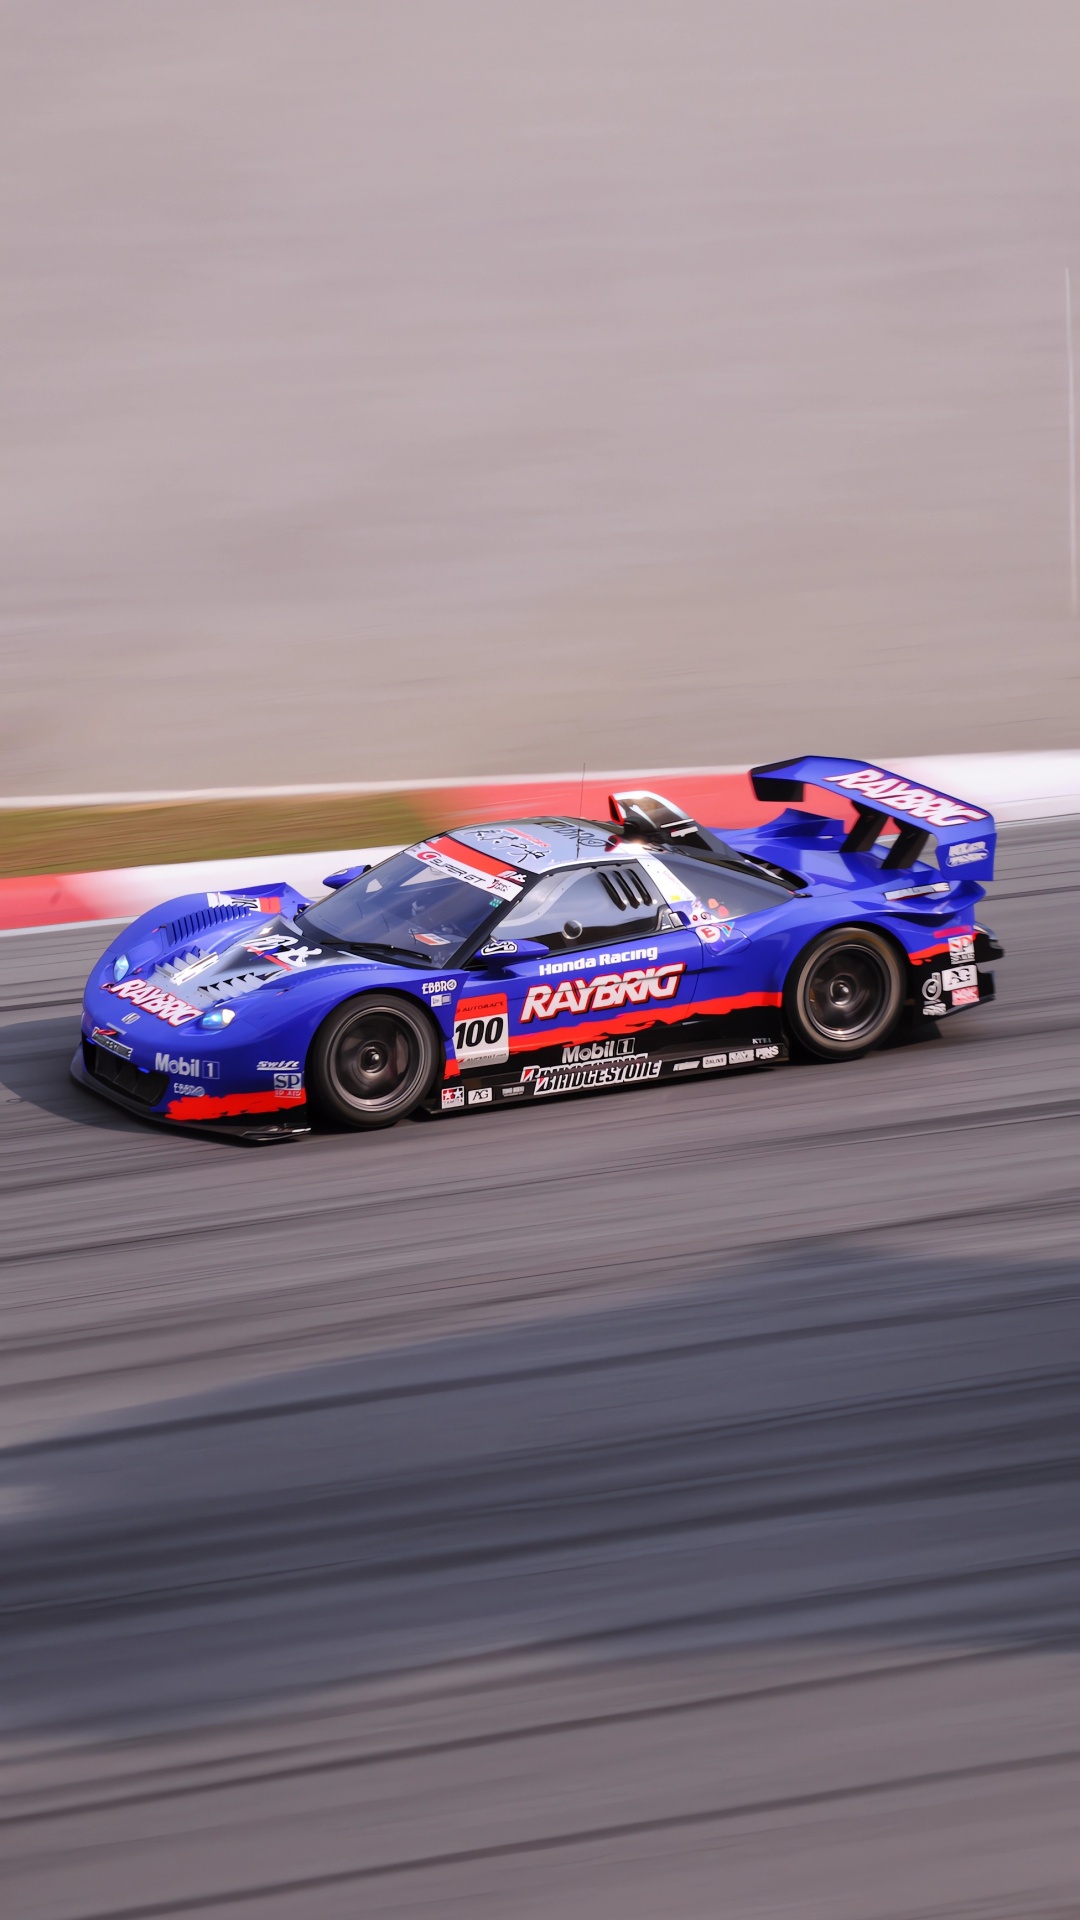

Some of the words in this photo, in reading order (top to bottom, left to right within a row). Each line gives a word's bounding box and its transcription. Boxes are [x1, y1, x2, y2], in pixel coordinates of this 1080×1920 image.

[822, 768, 989, 827] RAYBRIG
[539, 957, 600, 976] Honda
[602, 946, 658, 966] Racing
[421, 979, 457, 994] EBBRO
[519, 962, 686, 1023] RAYBRIG
[455, 1016, 504, 1050] 100
[155, 1052, 200, 1078] Mobil
[561, 1040, 615, 1064] Mobil
[275, 1074, 301, 1089] SP
[534, 1060, 662, 1095] BRIDGESTONE
